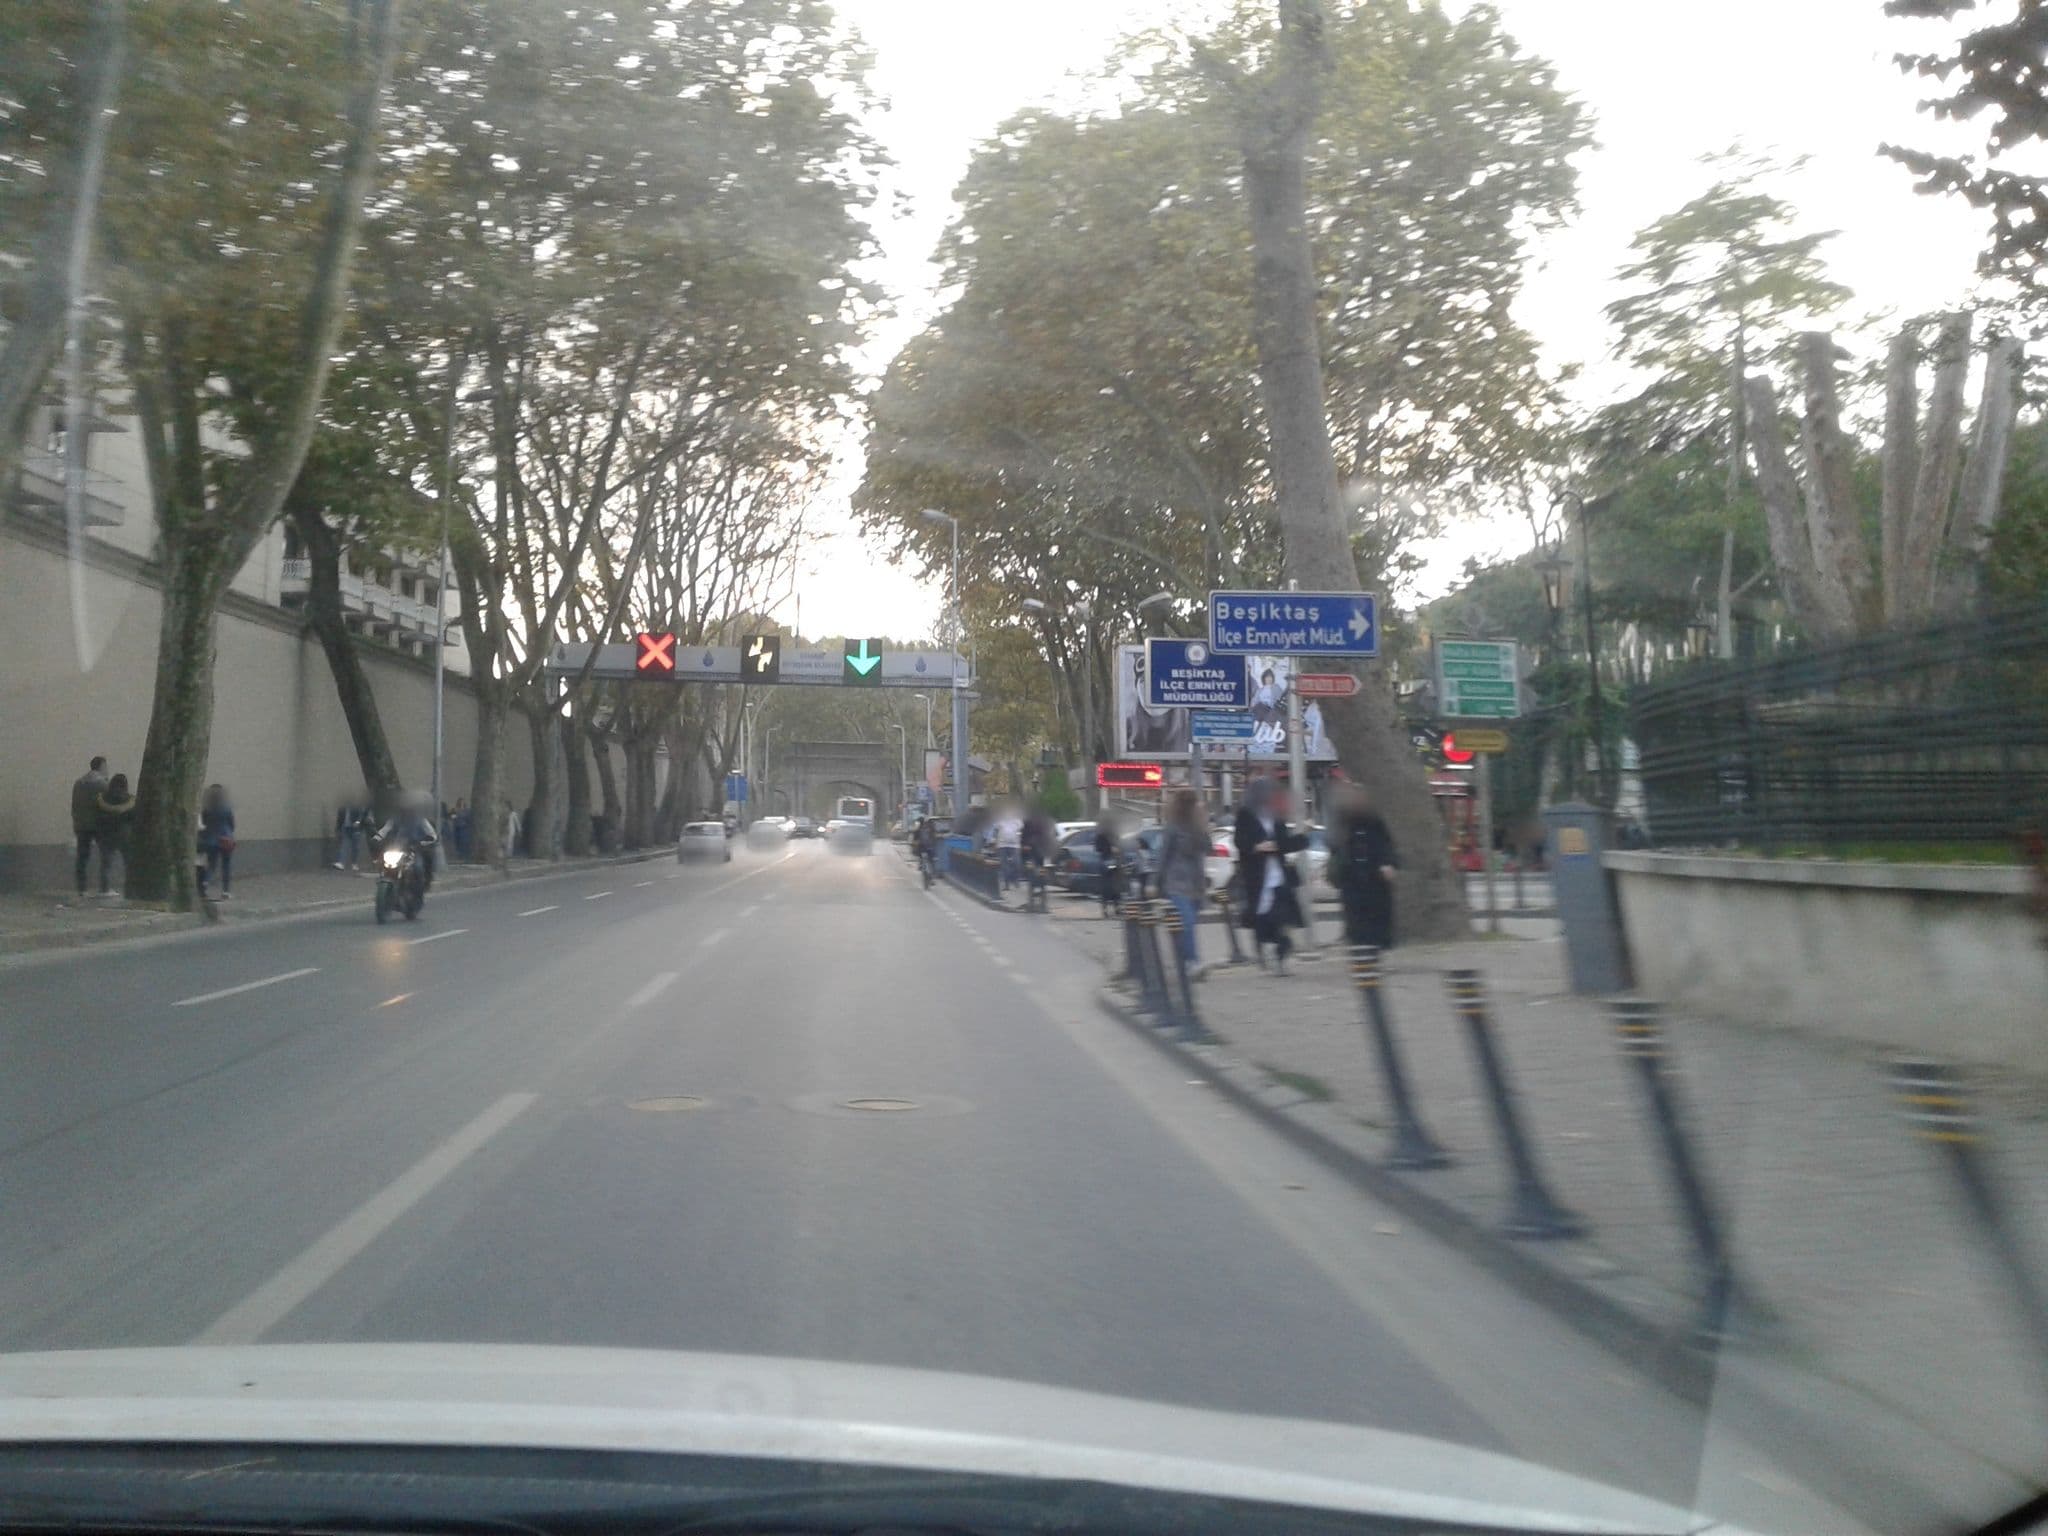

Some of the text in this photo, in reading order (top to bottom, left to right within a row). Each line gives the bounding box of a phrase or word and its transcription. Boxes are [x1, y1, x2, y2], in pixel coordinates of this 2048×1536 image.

[1216, 602, 1319, 622] Beşiktaş
[1218, 623, 1345, 649] İlçe Emniyet Müd.
[1171, 669, 1225, 680] BEŞİKTAŞ
[1160, 680, 1237, 691] İLÇE EMNİYET
[1163, 691, 1234, 702] MÜDÜRLÜĞÜ
